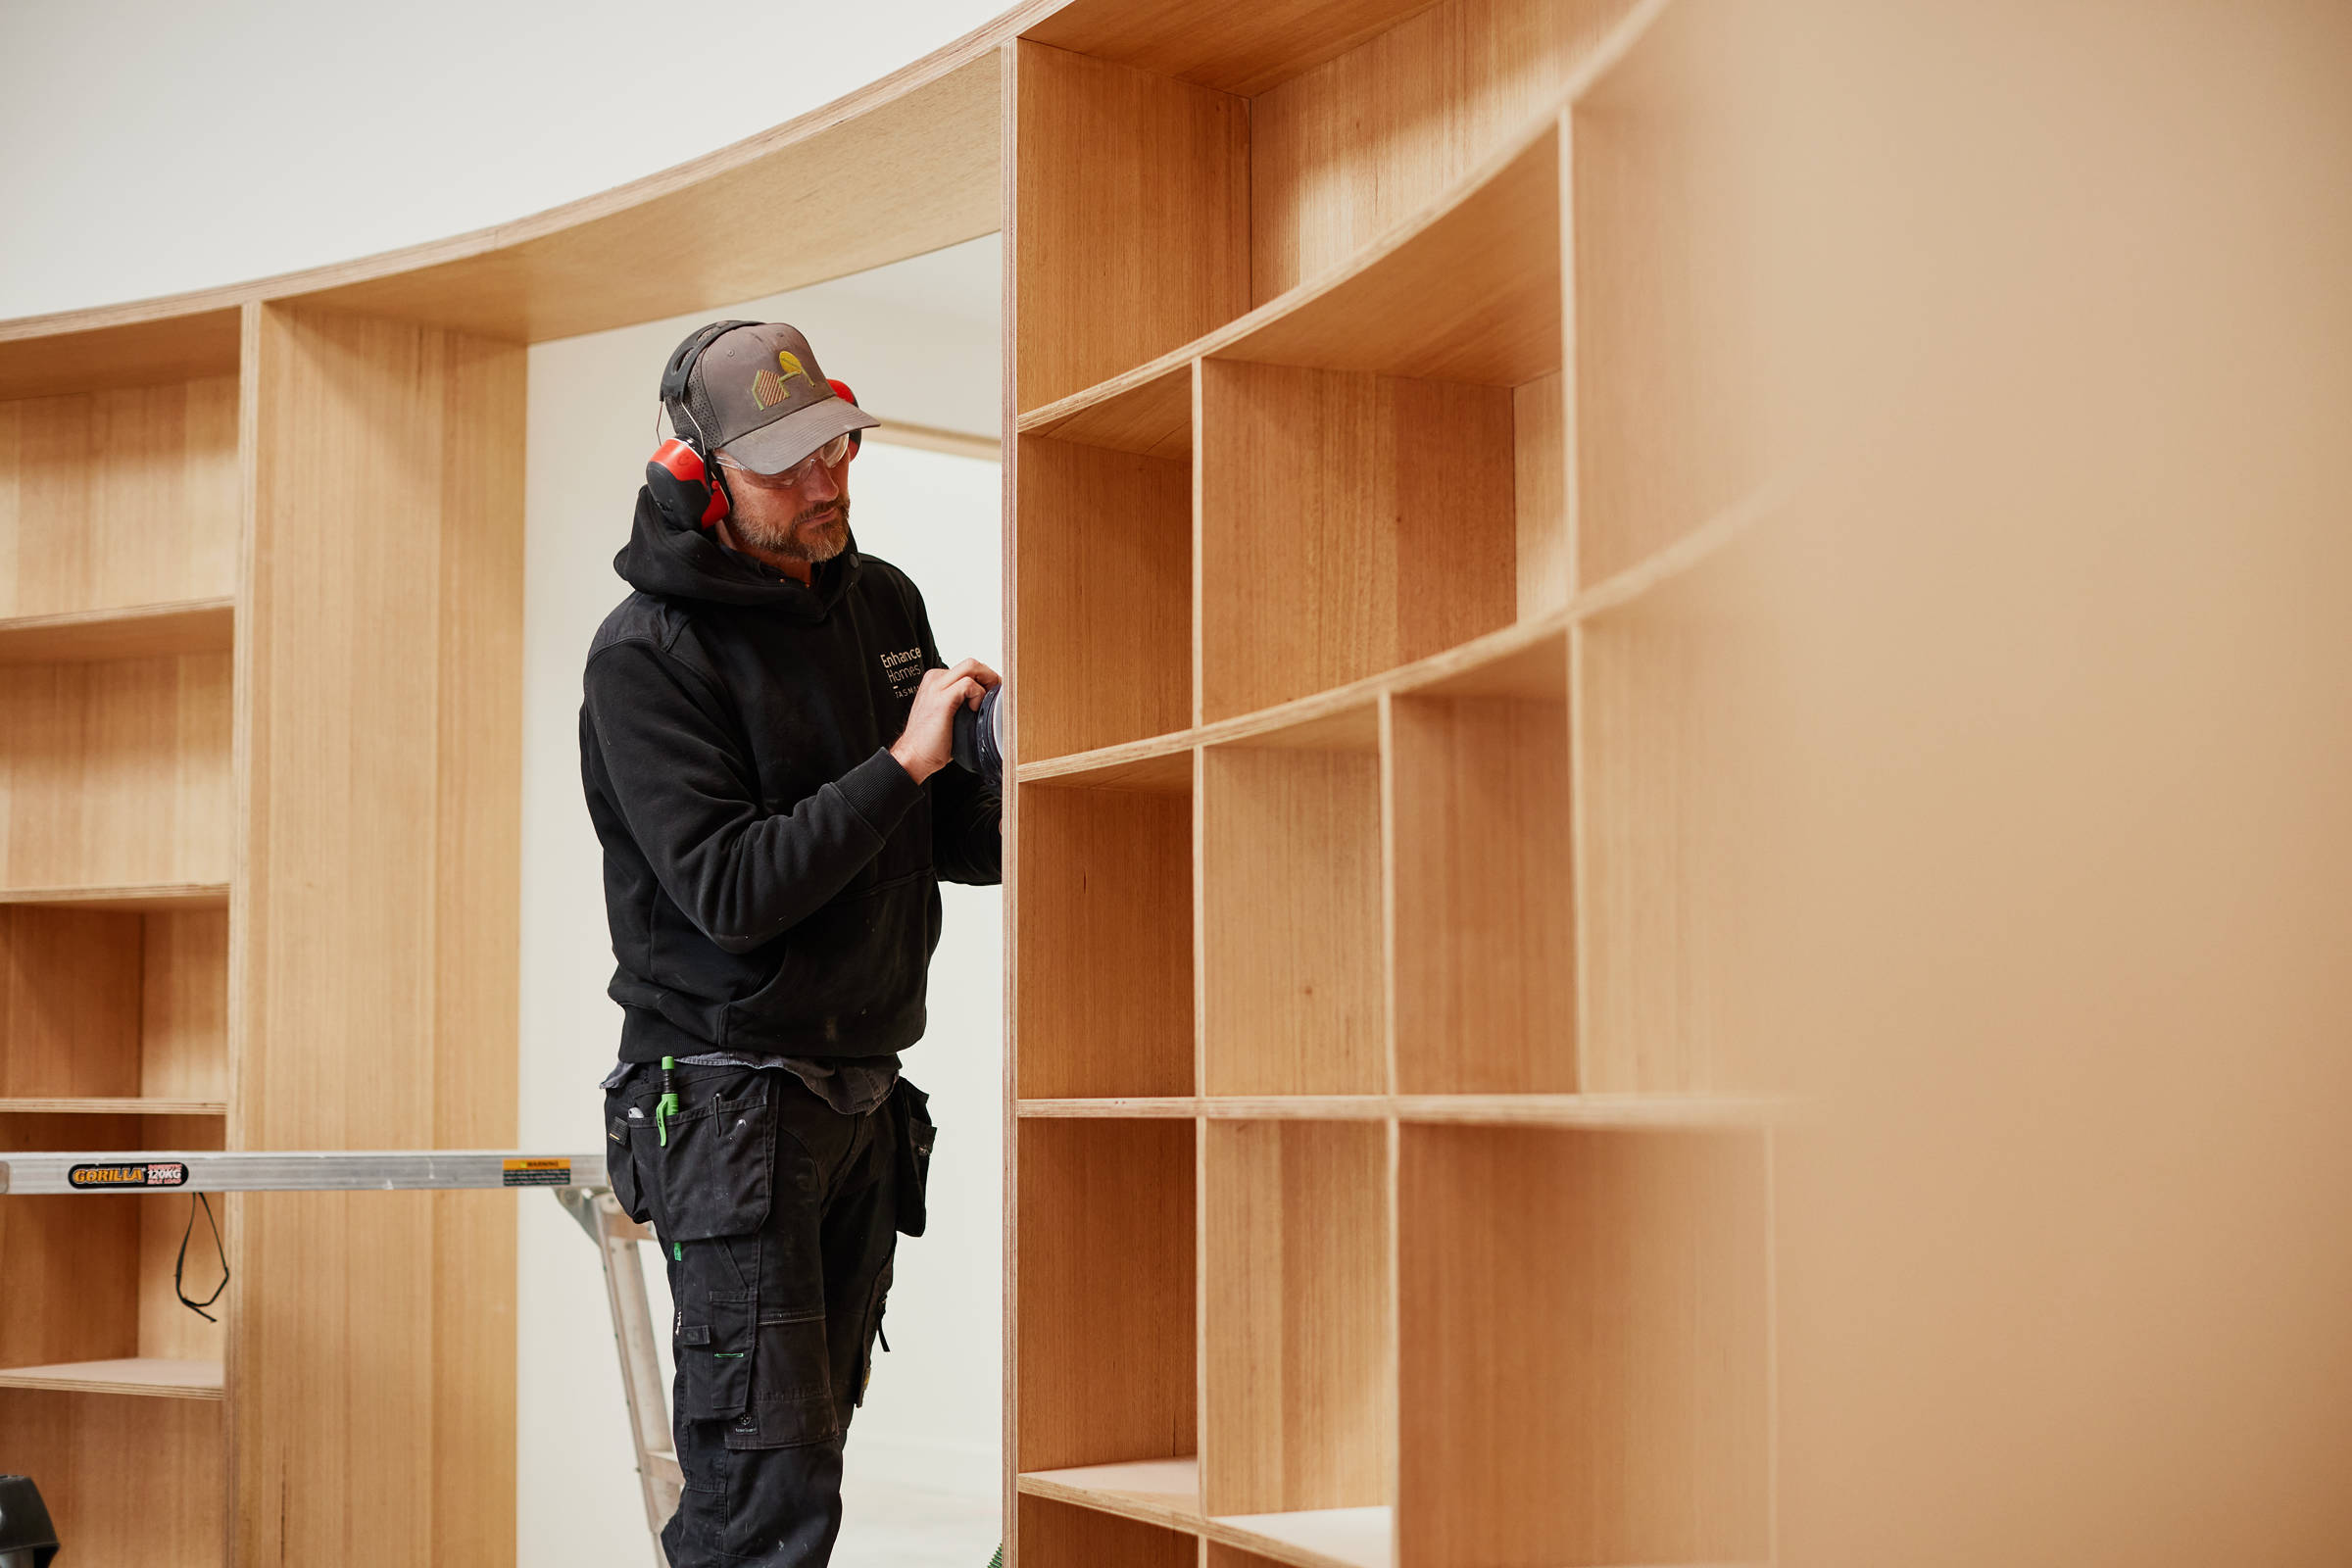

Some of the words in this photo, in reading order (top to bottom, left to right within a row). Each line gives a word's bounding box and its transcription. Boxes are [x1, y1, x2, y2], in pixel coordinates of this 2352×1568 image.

[880, 648, 921, 667] Enhance
[886, 664, 921, 683] Homes
[74, 1168, 144, 1184] GORILLA
[147, 1168, 181, 1179] 120KG
